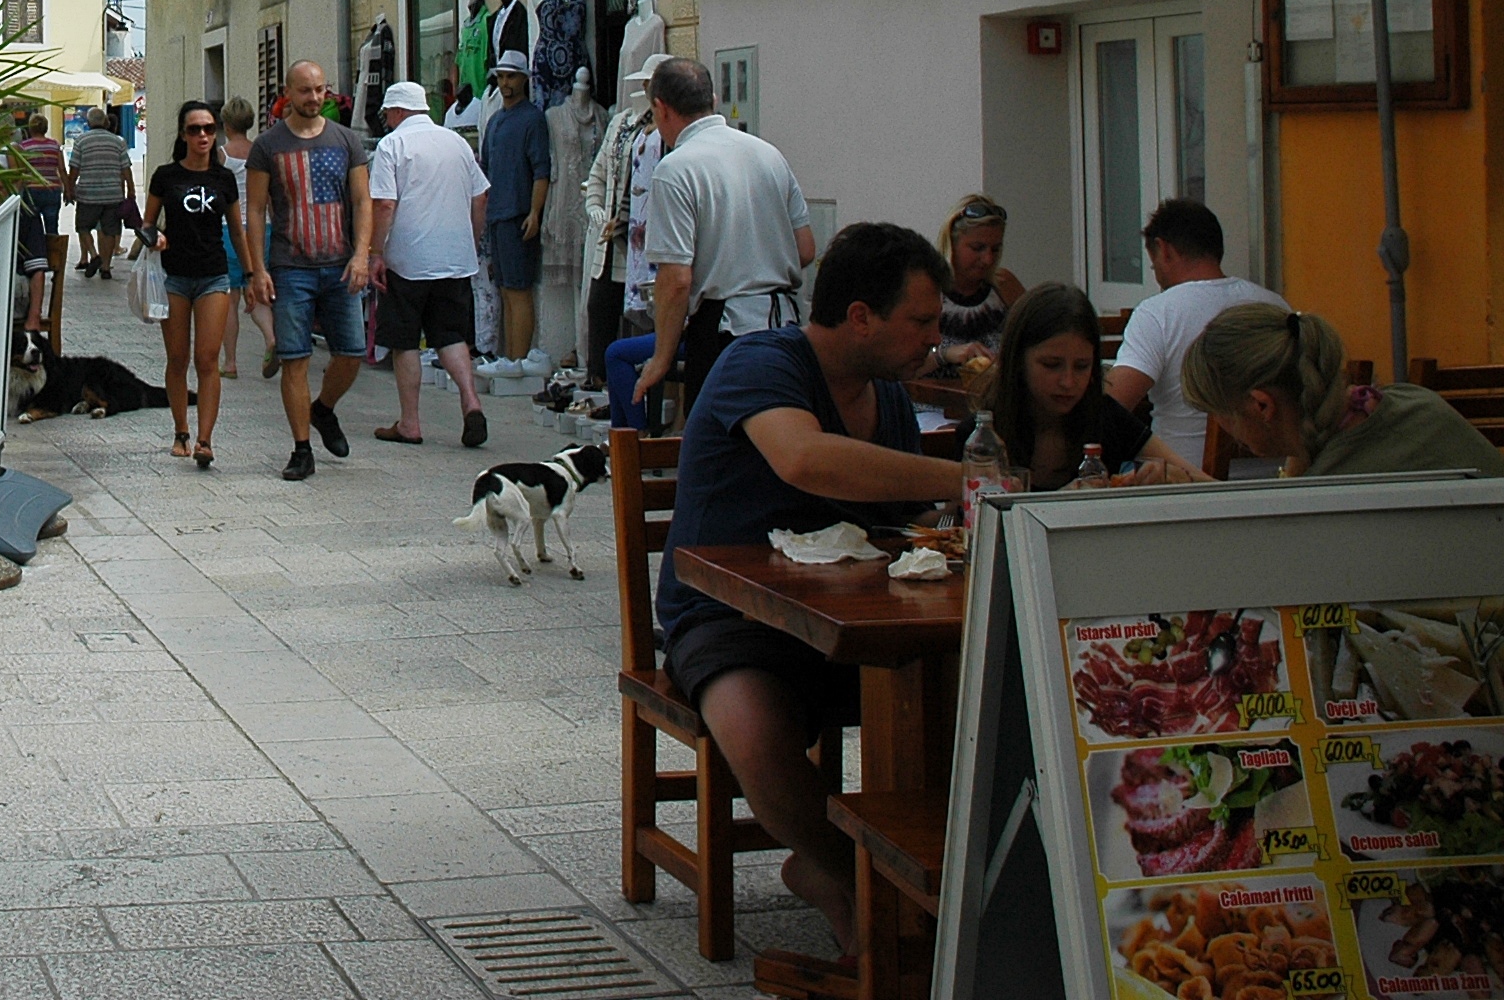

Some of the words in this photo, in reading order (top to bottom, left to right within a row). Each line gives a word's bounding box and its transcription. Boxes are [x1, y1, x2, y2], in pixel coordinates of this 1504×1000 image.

[1302, 604, 1344, 627] 60.00
[1076, 623, 1121, 641] Istarski
[1124, 622, 1157, 639] pršut
[1246, 694, 1286, 717] 60.00
[1326, 701, 1358, 718] Ovčji
[1359, 700, 1378, 715] sir
[1239, 751, 1290, 767] Tagliata
[1324, 741, 1364, 762] 60.00
[1350, 835, 1401, 852] Octopus
[1402, 833, 1439, 849] salat
[1347, 876, 1393, 895] 60.00
[1220, 889, 1282, 907] Calamari
[1283, 886, 1314, 902] fritti
[1292, 970, 1342, 992] 65.00
[1379, 976, 1439, 994] Calamari
[1441, 977, 1456, 991] na
[1457, 972, 1491, 991] žaru
